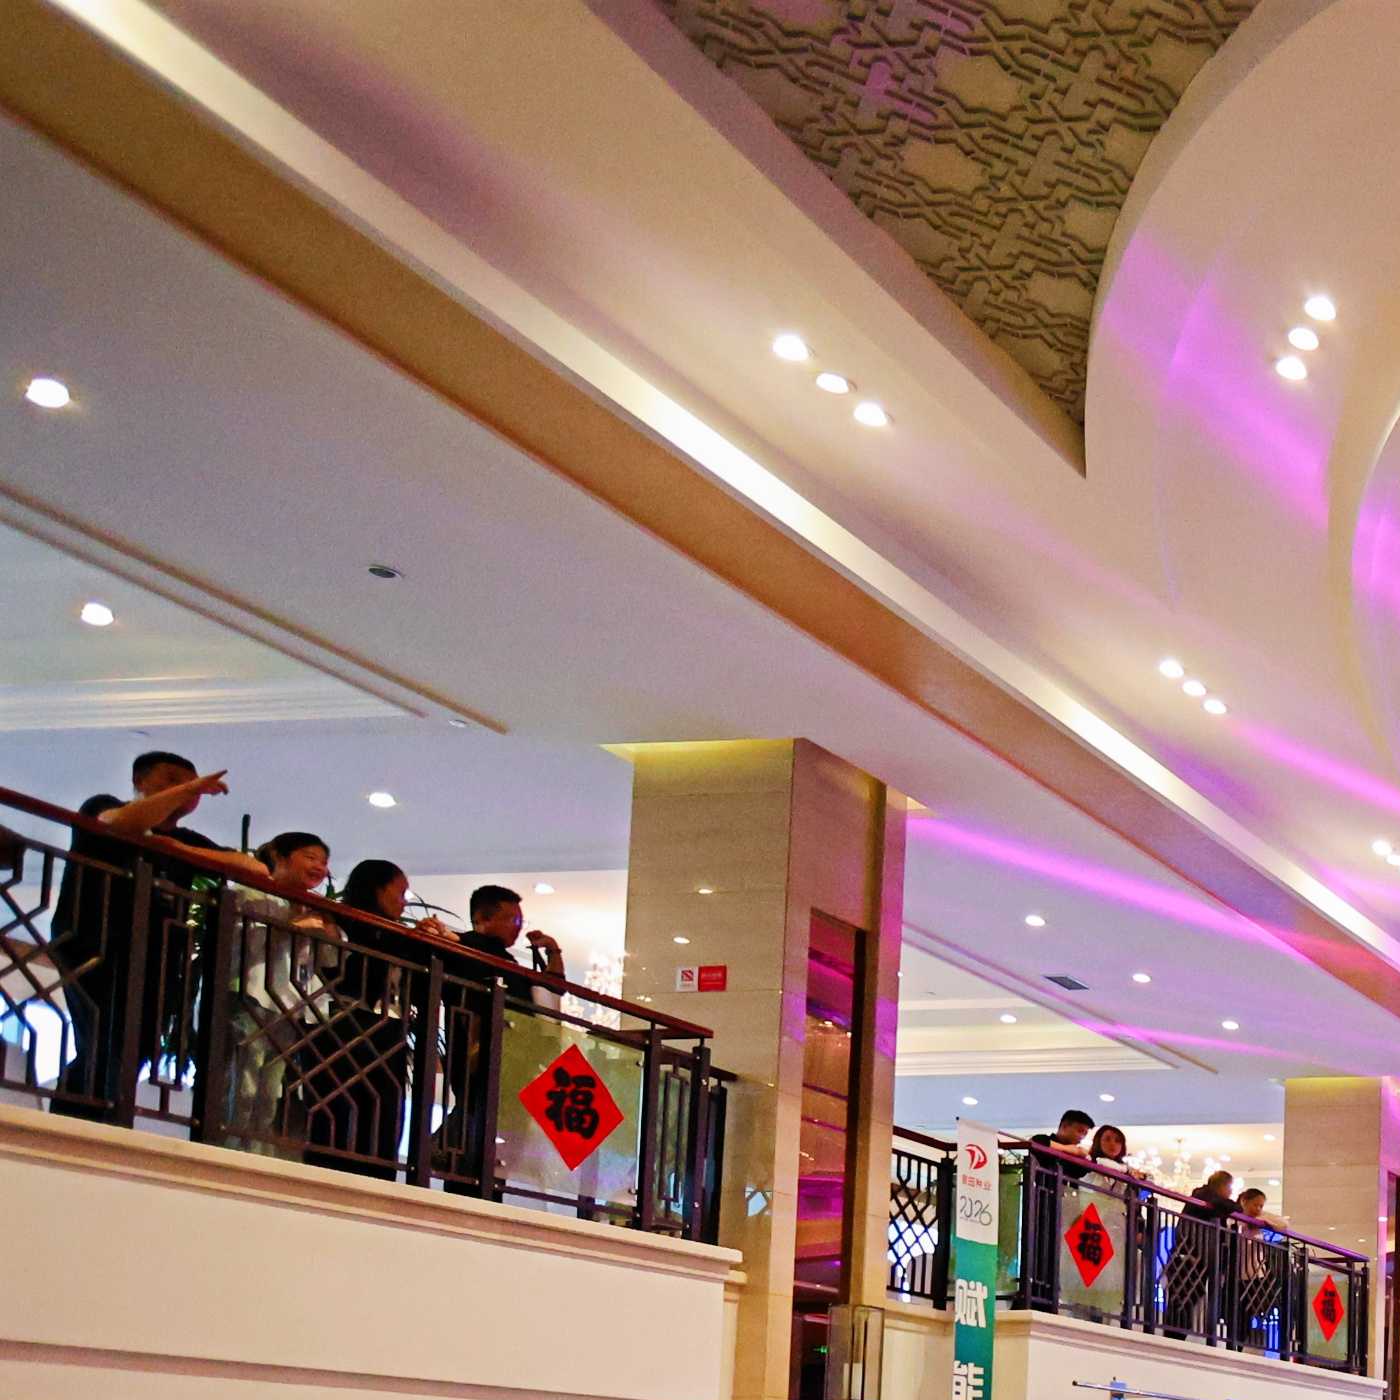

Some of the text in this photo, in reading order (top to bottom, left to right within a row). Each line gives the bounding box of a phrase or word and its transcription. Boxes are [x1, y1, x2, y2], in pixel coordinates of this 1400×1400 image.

[545, 1067, 600, 1138] 福
[960, 1196, 992, 1226] 2026
[1078, 1220, 1103, 1265] 福
